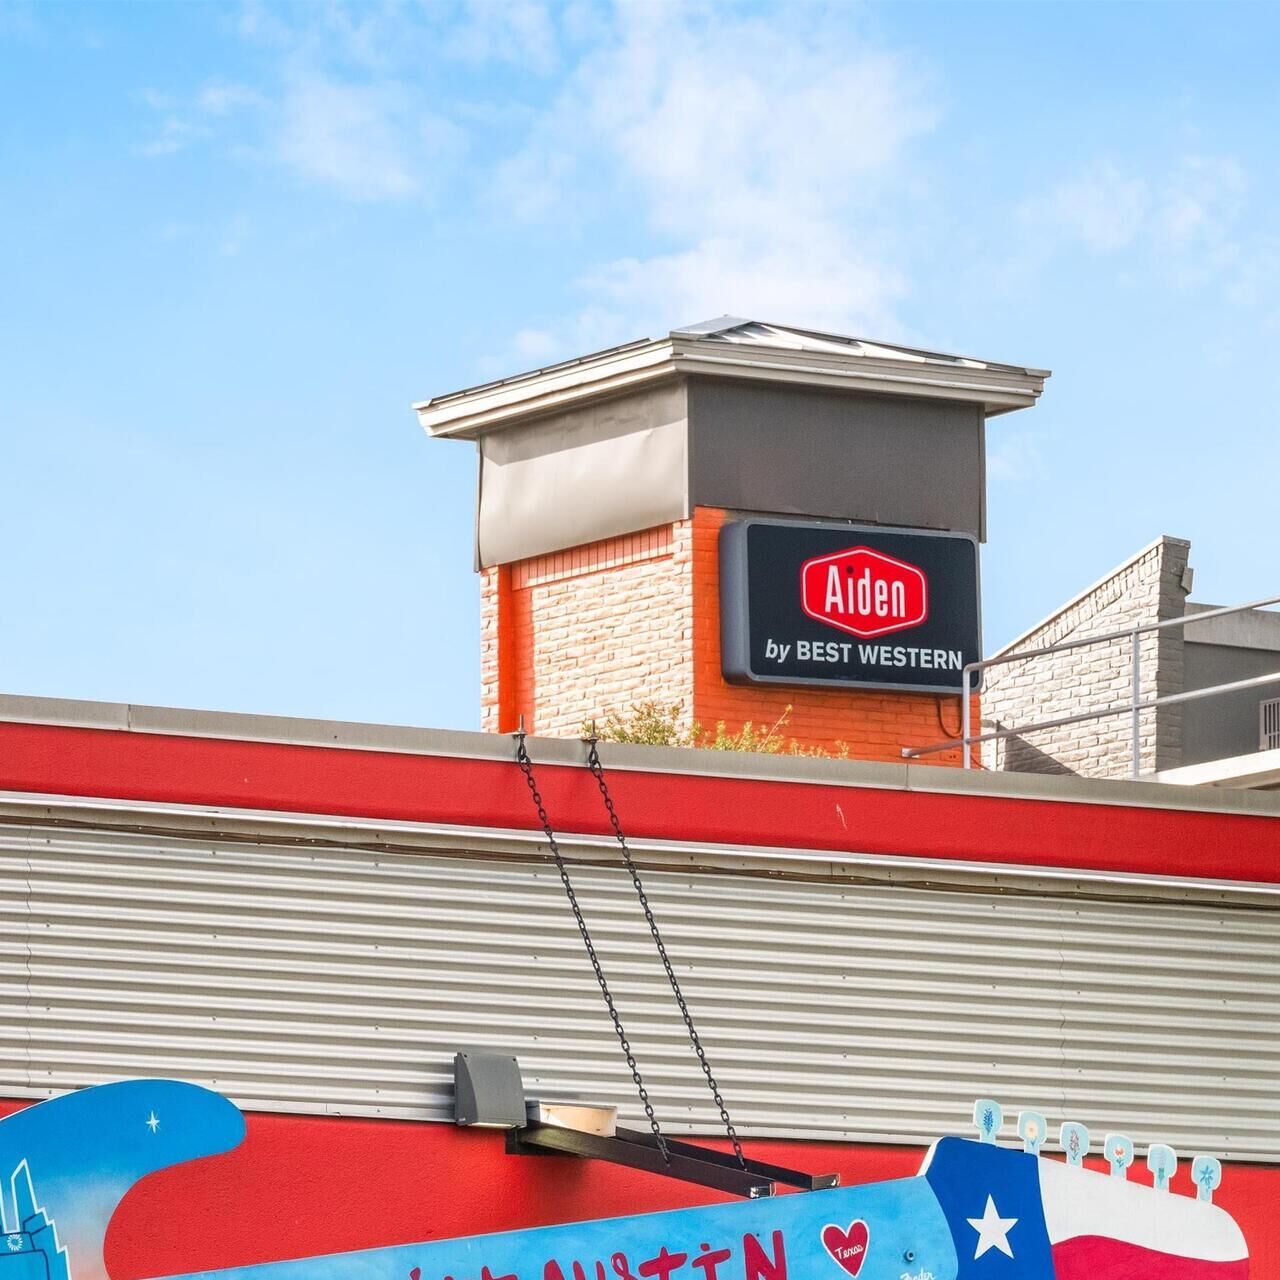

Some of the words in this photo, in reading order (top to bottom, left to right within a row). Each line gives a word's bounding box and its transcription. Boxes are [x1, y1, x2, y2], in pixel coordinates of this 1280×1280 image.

[825, 565, 906, 618] Aiden
[765, 638, 791, 664] by
[796, 640, 852, 663] BEST
[858, 646, 962, 670] WESTERN
[835, 1244, 864, 1260] Texas
